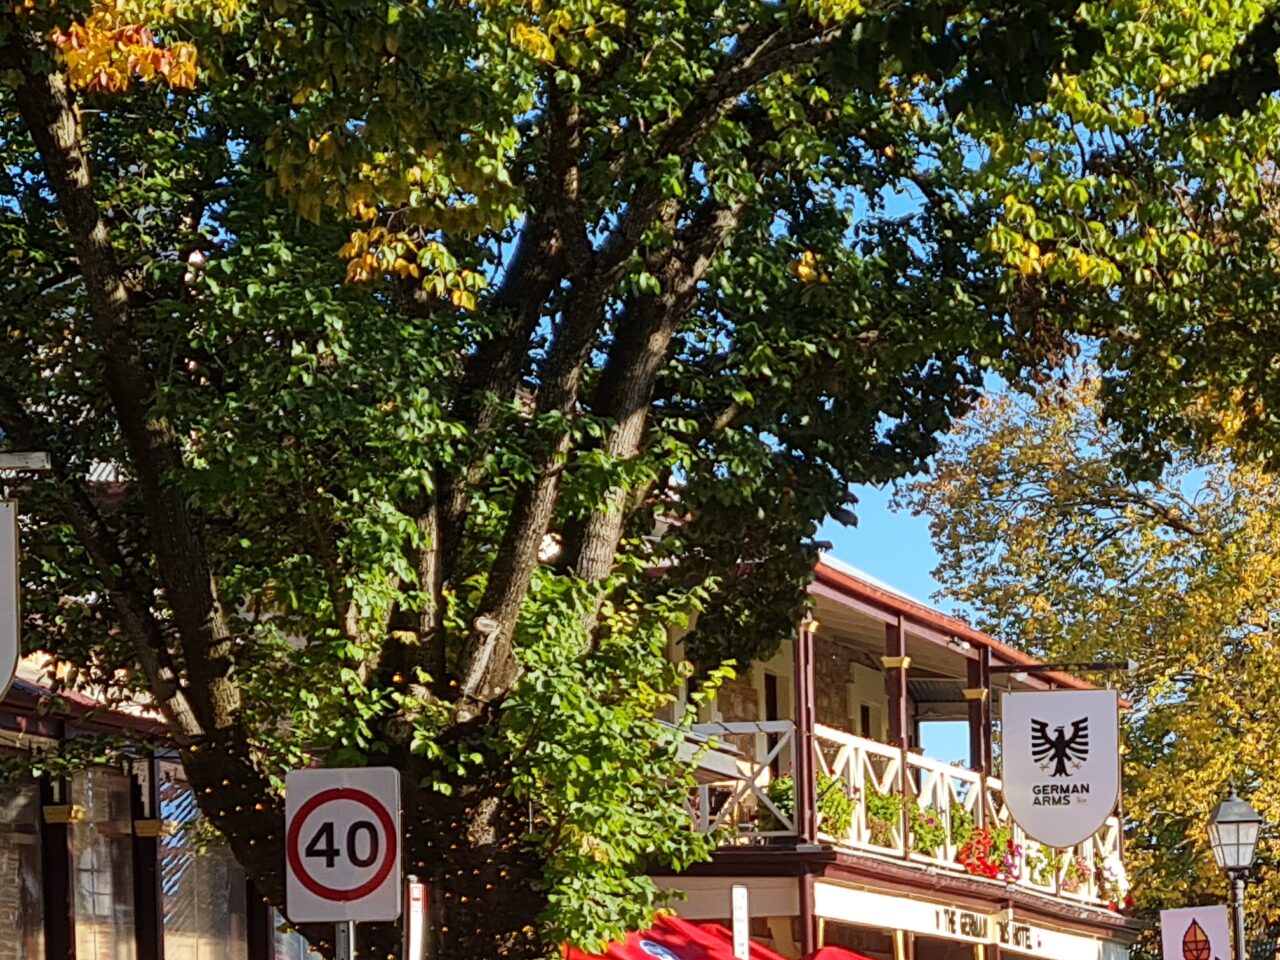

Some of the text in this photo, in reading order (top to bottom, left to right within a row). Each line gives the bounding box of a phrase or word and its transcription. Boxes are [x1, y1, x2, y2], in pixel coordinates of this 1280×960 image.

[1032, 784, 1090, 795] GERMAN
[1033, 795, 1071, 806] ARMS
[305, 820, 379, 868] 40
[944, 908, 956, 934] THE
[1013, 924, 1032, 950] HOTEL
